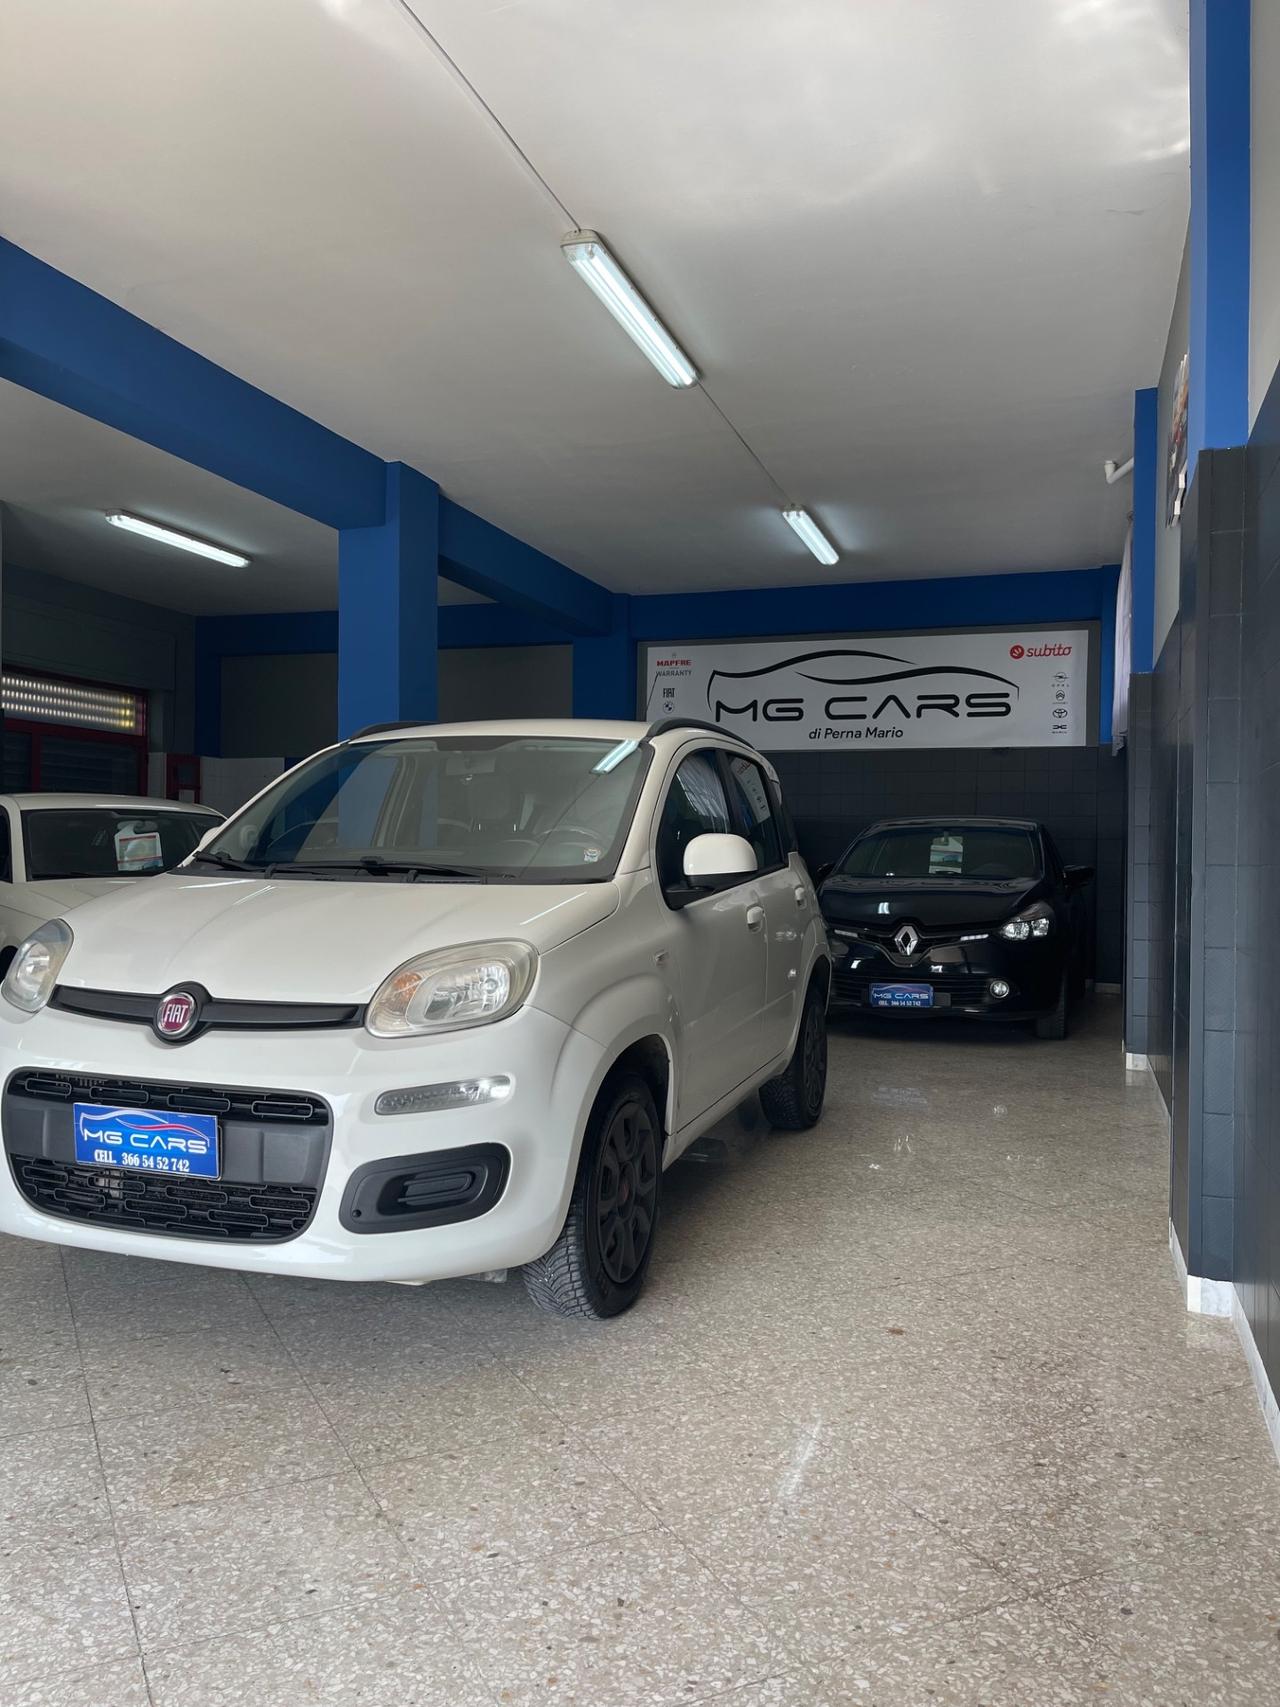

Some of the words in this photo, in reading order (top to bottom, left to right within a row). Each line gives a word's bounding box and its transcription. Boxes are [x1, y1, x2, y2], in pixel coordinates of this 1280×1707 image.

[1026, 643, 1073, 657] subito
[656, 659, 692, 667] MAPFRE
[715, 697, 804, 723] MG
[824, 692, 1011, 721] CARS
[808, 728, 821, 740] di
[824, 726, 862, 740] Perna
[865, 726, 904, 739] Mario
[164, 1003, 189, 1024] FIAT
[84, 1128, 123, 1145] MG
[130, 1134, 208, 1154] CARS
[94, 1149, 117, 1164] CELL.
[121, 1152, 140, 1166] 366
[142, 1155, 154, 1168] 54
[156, 1156, 169, 1170] 52
[171, 1157, 190, 1172] 742
